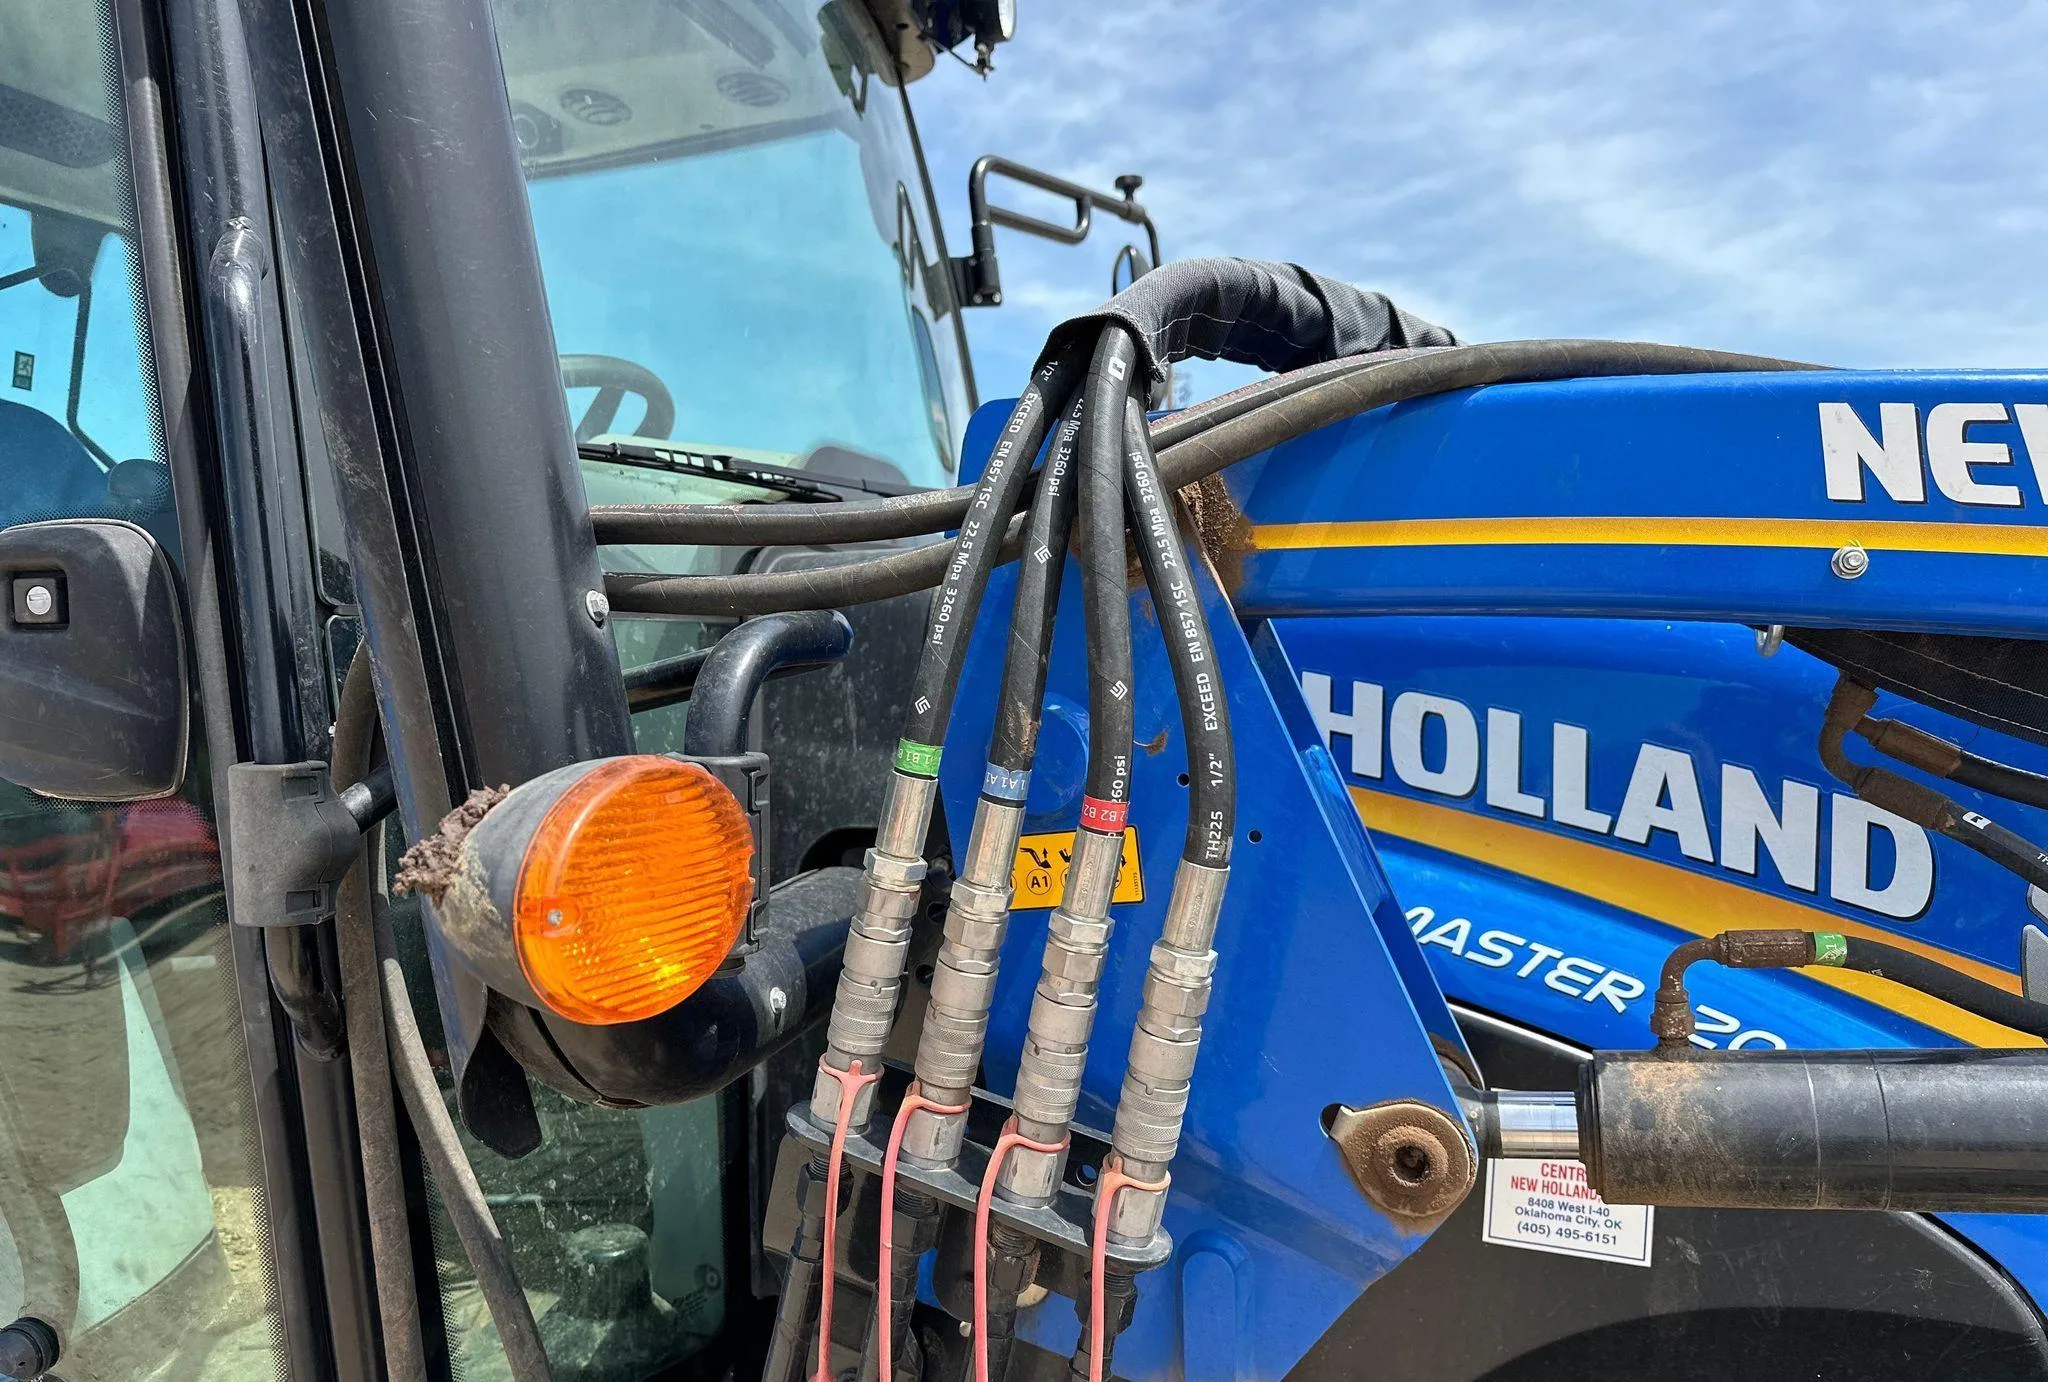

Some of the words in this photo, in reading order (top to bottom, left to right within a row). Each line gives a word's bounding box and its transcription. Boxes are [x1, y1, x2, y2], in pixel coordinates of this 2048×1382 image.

[1040, 360, 1058, 382] 1/2"
[1008, 392, 1039, 434] EXCEED
[1063, 420, 1081, 442] Mpa
[999, 440, 1013, 458] EN
[1055, 446, 1072, 476] 3260
[1128, 452, 1148, 469] psi
[987, 459, 1004, 483] 857
[1048, 478, 1060, 497] psi
[1136, 471, 1155, 503] 3260
[1150, 508, 1166, 537] Mpa
[962, 520, 980, 550] 22.5
[951, 552, 970, 581] Mpa
[1157, 540, 1177, 569] 22.5
[938, 587, 958, 622] 3260
[1171, 581, 1188, 607] 1SC
[932, 624, 943, 646] psi
[1180, 611, 1198, 639] 857
[1188, 641, 1204, 662] EN
[1196, 673, 1219, 731] EXCEED
[1114, 755, 1127, 776] psi
[1208, 753, 1224, 787] 1/2"
[1001, 776, 1017, 790] A1
[1302, 672, 1934, 918] HOLLAND
[1083, 804, 1097, 819] B2
[1100, 809, 1117, 822] B2
[1205, 811, 1223, 859] TH225
[1031, 875, 1048, 889] A1
[1510, 1175, 1538, 1192] NEW
[1541, 1162, 1587, 1182] CENTR
[1515, 1206, 1572, 1223] Oklahoma
[1576, 1215, 1601, 1229] City,
[1604, 1218, 1622, 1230] OK
[1528, 1196, 1555, 1209] 8408
[1558, 1201, 1585, 1214] West
[1589, 1205, 1610, 1218] I-40
[1517, 1221, 1551, 1237] (405)
[1556, 1228, 1617, 1246] 495-6151
